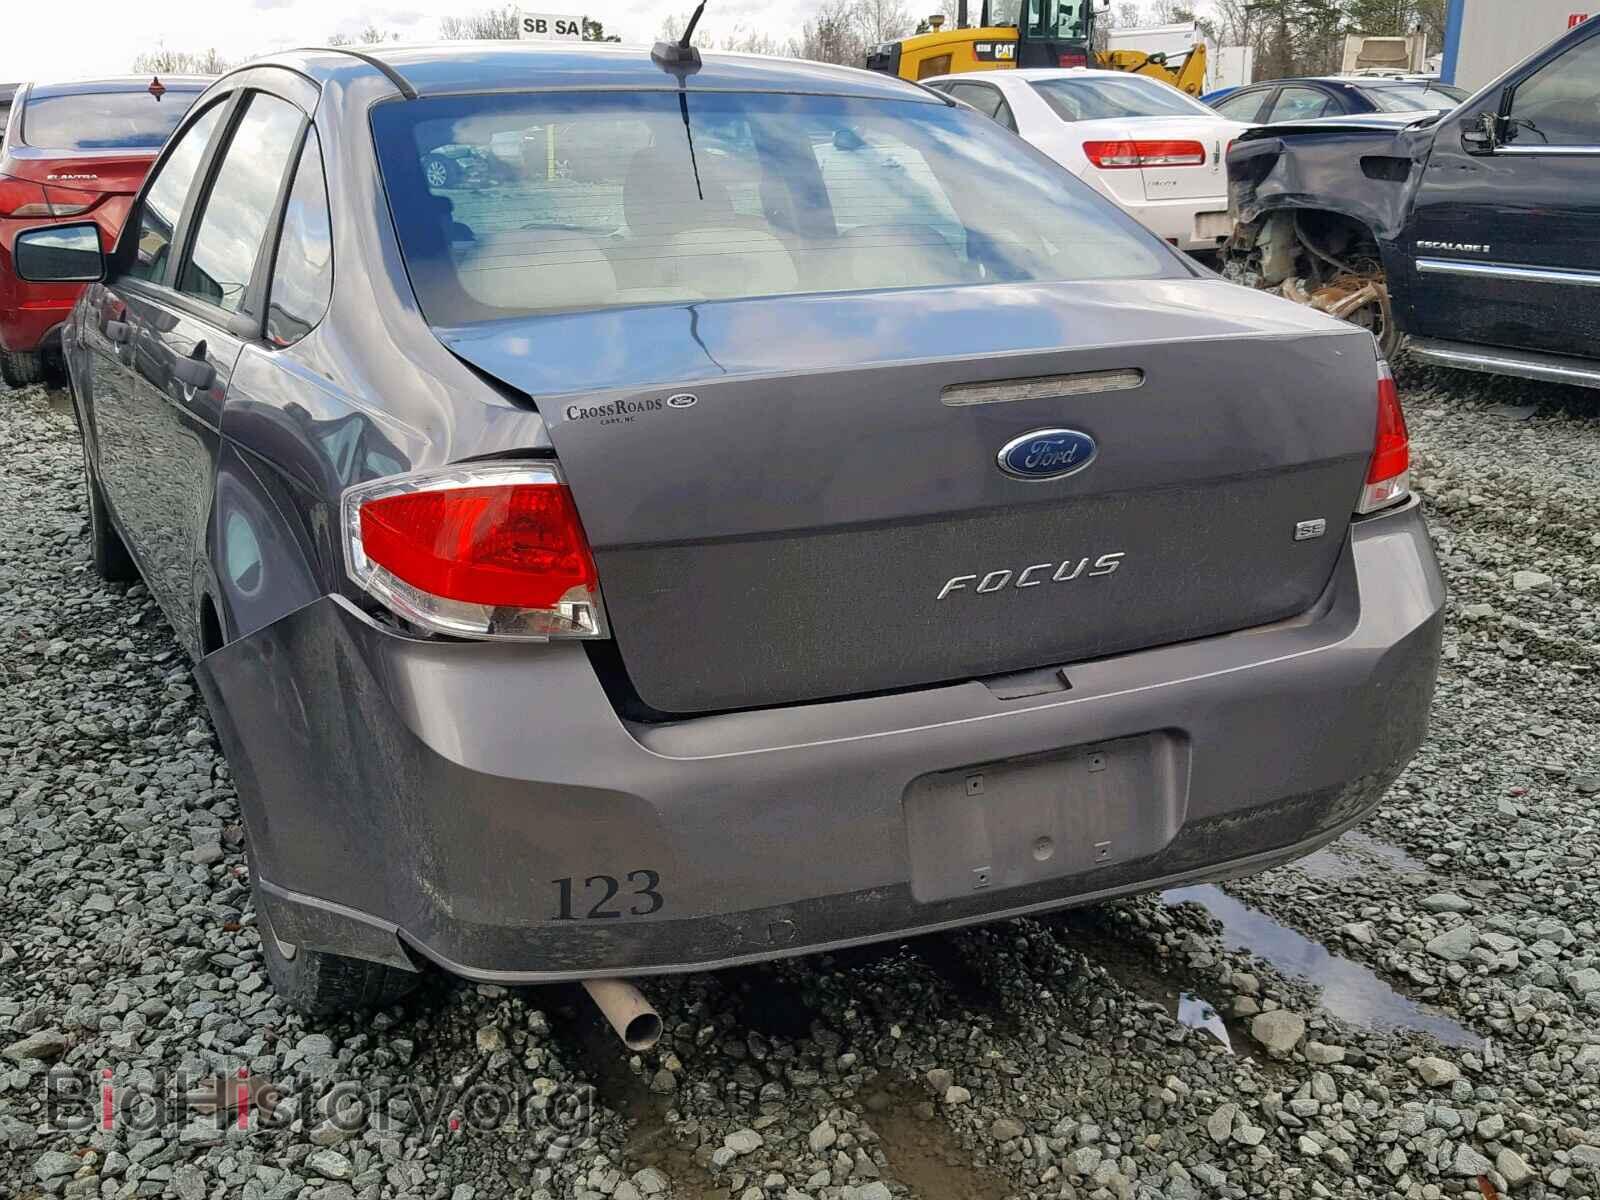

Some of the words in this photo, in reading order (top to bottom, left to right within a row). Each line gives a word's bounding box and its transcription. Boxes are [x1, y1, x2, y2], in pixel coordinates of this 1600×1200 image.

[523, 18, 548, 34] SB
[555, 20, 579, 36] SA
[994, 44, 1016, 59] CAT
[1416, 240, 1482, 253] ESCALADE
[1024, 439, 1078, 469] Ford
[937, 551, 1126, 600] FOCUS
[551, 869, 665, 921] 123
